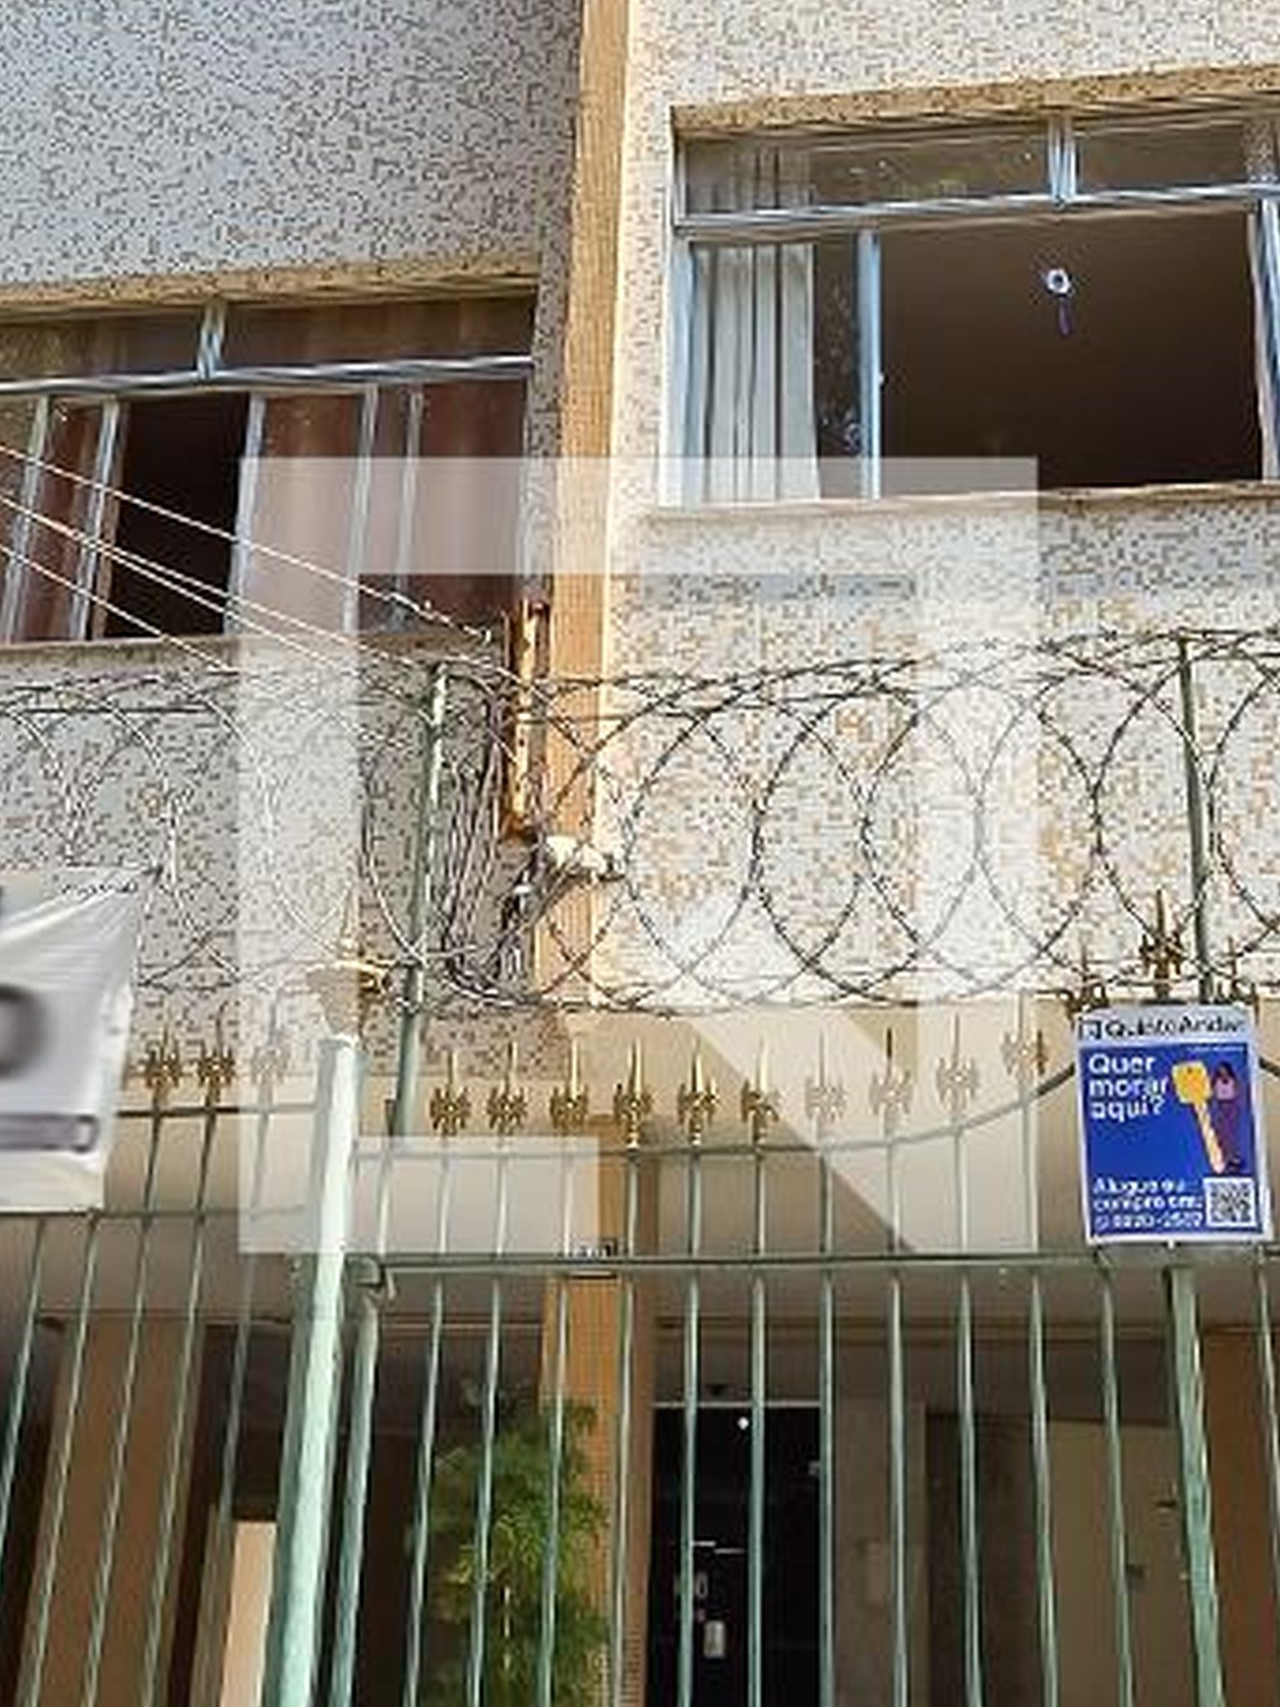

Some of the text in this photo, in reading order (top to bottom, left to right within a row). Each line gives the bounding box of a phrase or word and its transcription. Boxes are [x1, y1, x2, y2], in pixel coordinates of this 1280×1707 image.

[1088, 1053, 1156, 1074] Quer
[1089, 1076, 1169, 1098] morar
[1091, 1095, 1165, 1123] aqui?
